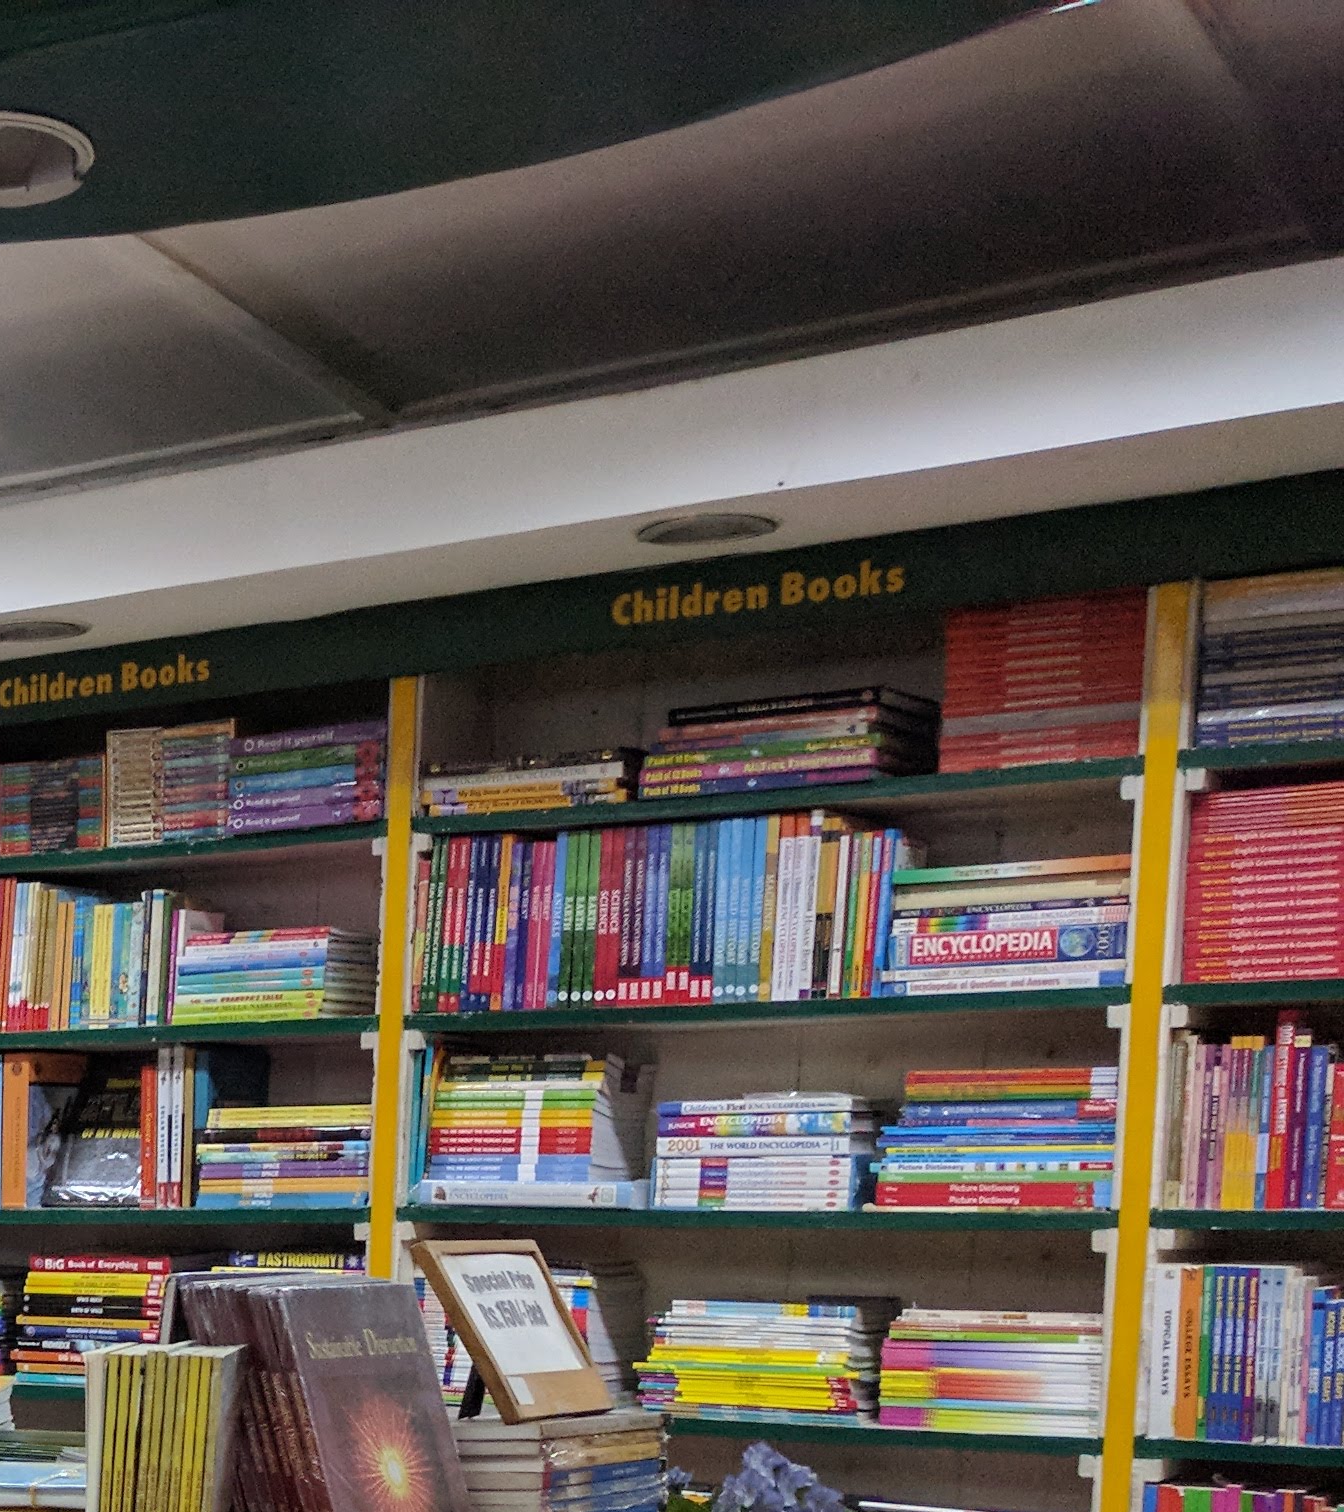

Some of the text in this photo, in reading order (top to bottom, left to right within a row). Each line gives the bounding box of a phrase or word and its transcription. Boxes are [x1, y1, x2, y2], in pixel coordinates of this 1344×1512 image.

[612, 559, 905, 626] Children Books
[121, 653, 210, 692] Books
[912, 931, 1054, 957] ENCYCLOPEDIA
[700, 1114, 783, 1126] ENCYCLOPEDIA
[667, 1139, 820, 1151] 2001 THE WORLD ENCYCLOPEDIA
[68, 1259, 85, 1268] Book
[98, 1259, 139, 1271] Everything
[265, 1253, 336, 1268] ASTRONOMY
[462, 1269, 536, 1295] Special Price
